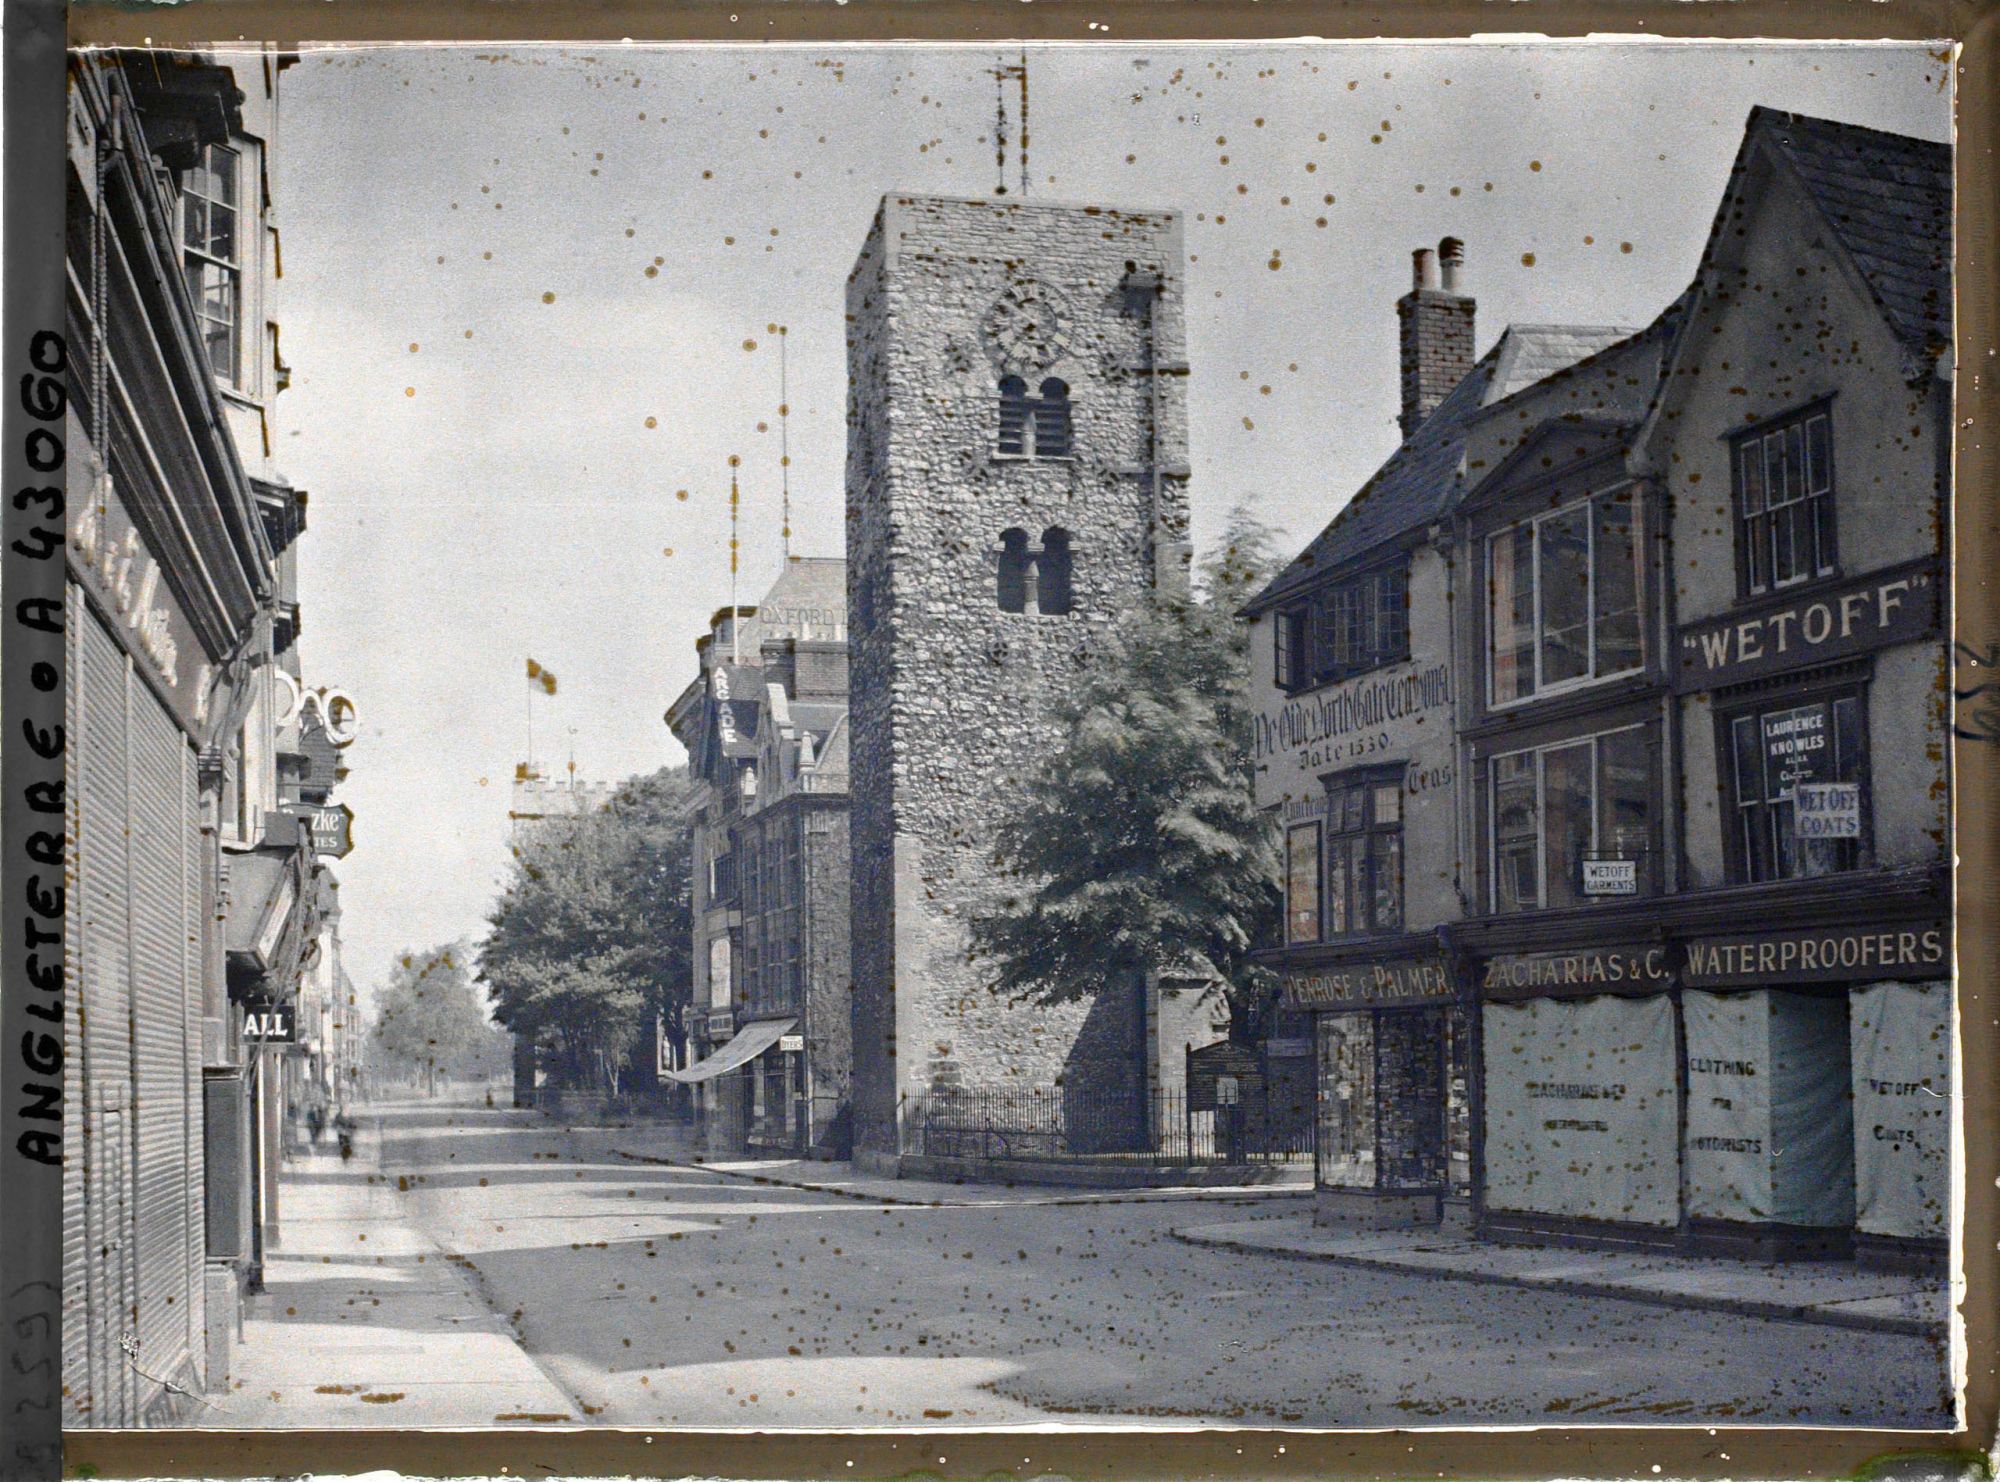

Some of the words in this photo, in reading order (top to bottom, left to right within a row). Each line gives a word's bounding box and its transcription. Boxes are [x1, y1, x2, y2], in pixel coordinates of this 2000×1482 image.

[11, 329, 67, 560] 43060
[16, 597, 64, 634] A
[760, 606, 834, 626] OXFORD
[714, 666, 738, 743] ARCADE
[1766, 714, 1824, 737] LAURENCE
[1770, 735, 1825, 756] KNOWLES
[1408, 762, 1450, 796] Teas
[1800, 815, 1858, 834] COATS
[1586, 879, 1636, 891] GARMENTS
[16, 717, 66, 1166] ANGLETERRE
[1685, 930, 1944, 976] WATERPROOFERS
[1482, 953, 1624, 989] ZACHARIAS
[1629, 959, 1641, 981] &
